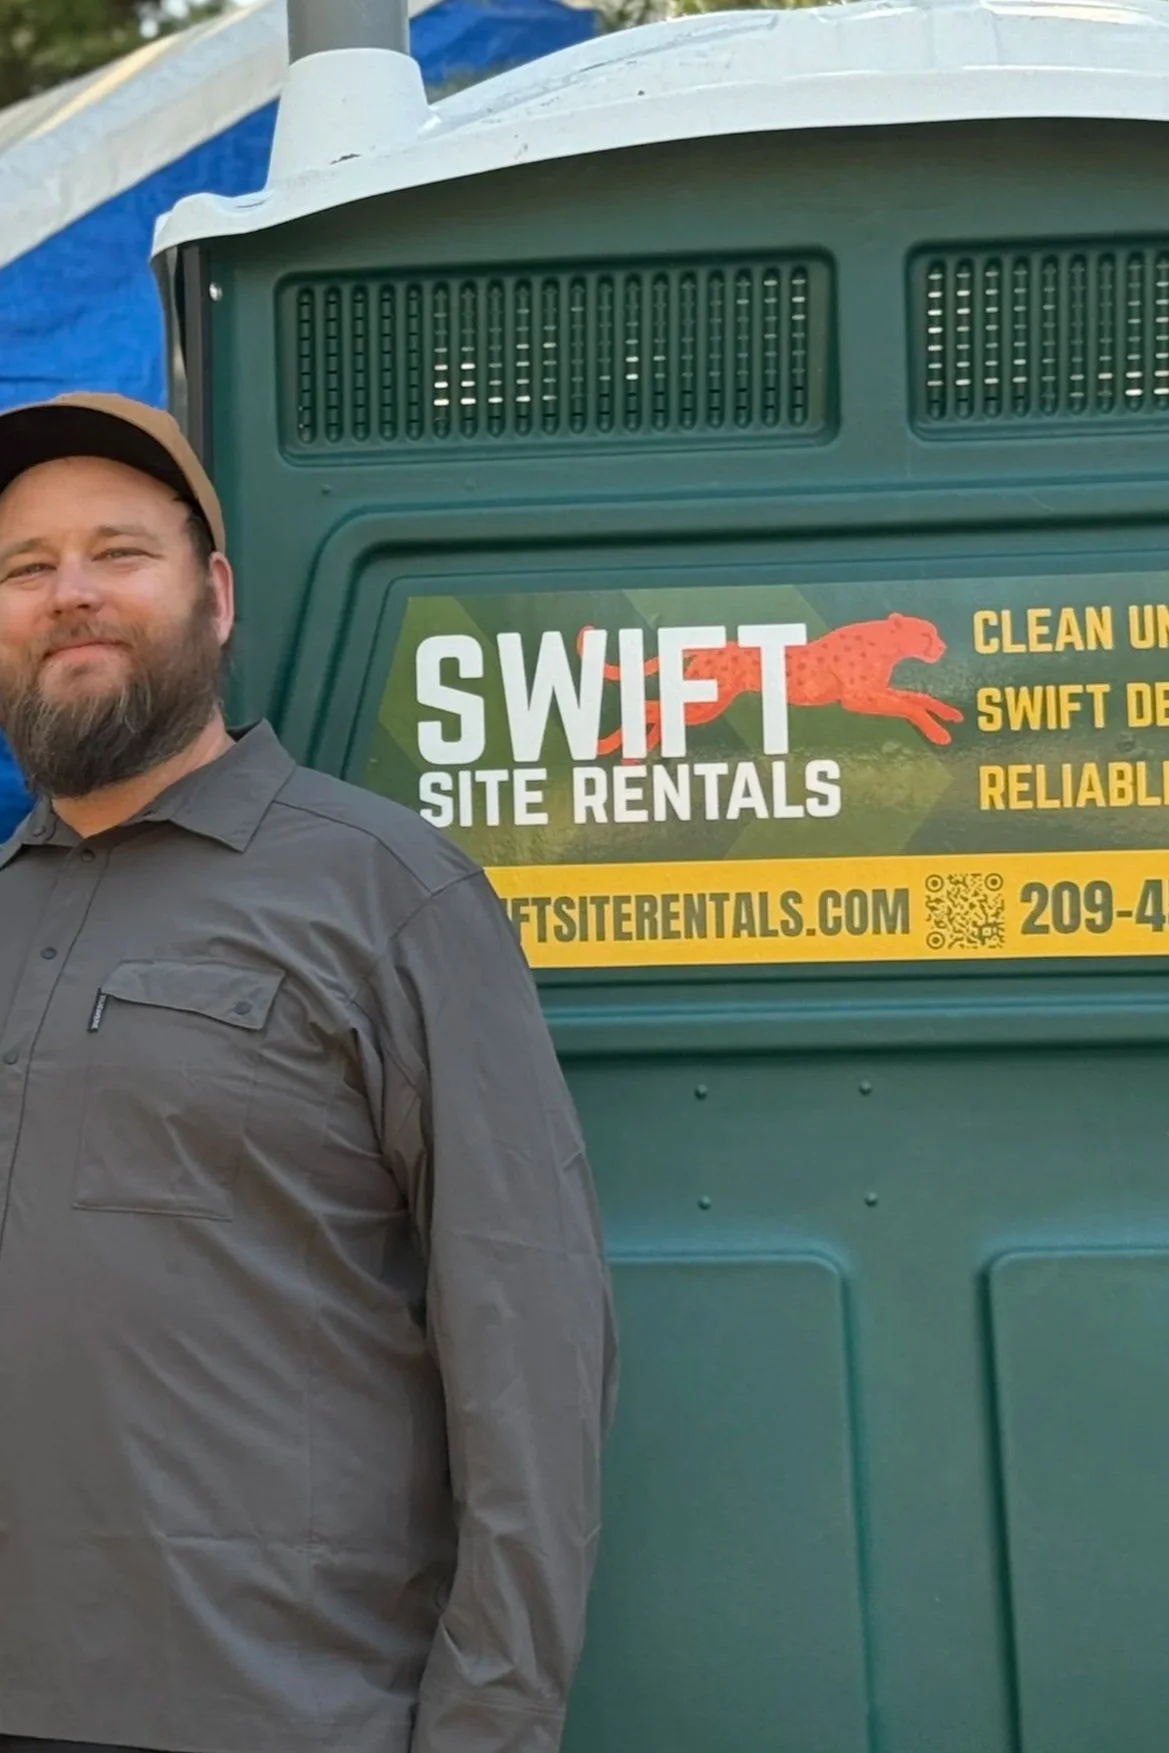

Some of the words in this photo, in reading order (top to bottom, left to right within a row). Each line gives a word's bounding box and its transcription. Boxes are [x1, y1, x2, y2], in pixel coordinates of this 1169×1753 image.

[973, 606, 1114, 654] CLEAN
[416, 623, 807, 765] SWIFT
[976, 683, 1111, 732] SWIFT
[419, 769, 549, 829] SITE
[572, 759, 842, 825] RENTALS
[979, 760, 1169, 811] RELIABL
[499, 887, 911, 944] FTSITERENTALS.COM
[1019, 878, 1169, 935] 209-4
